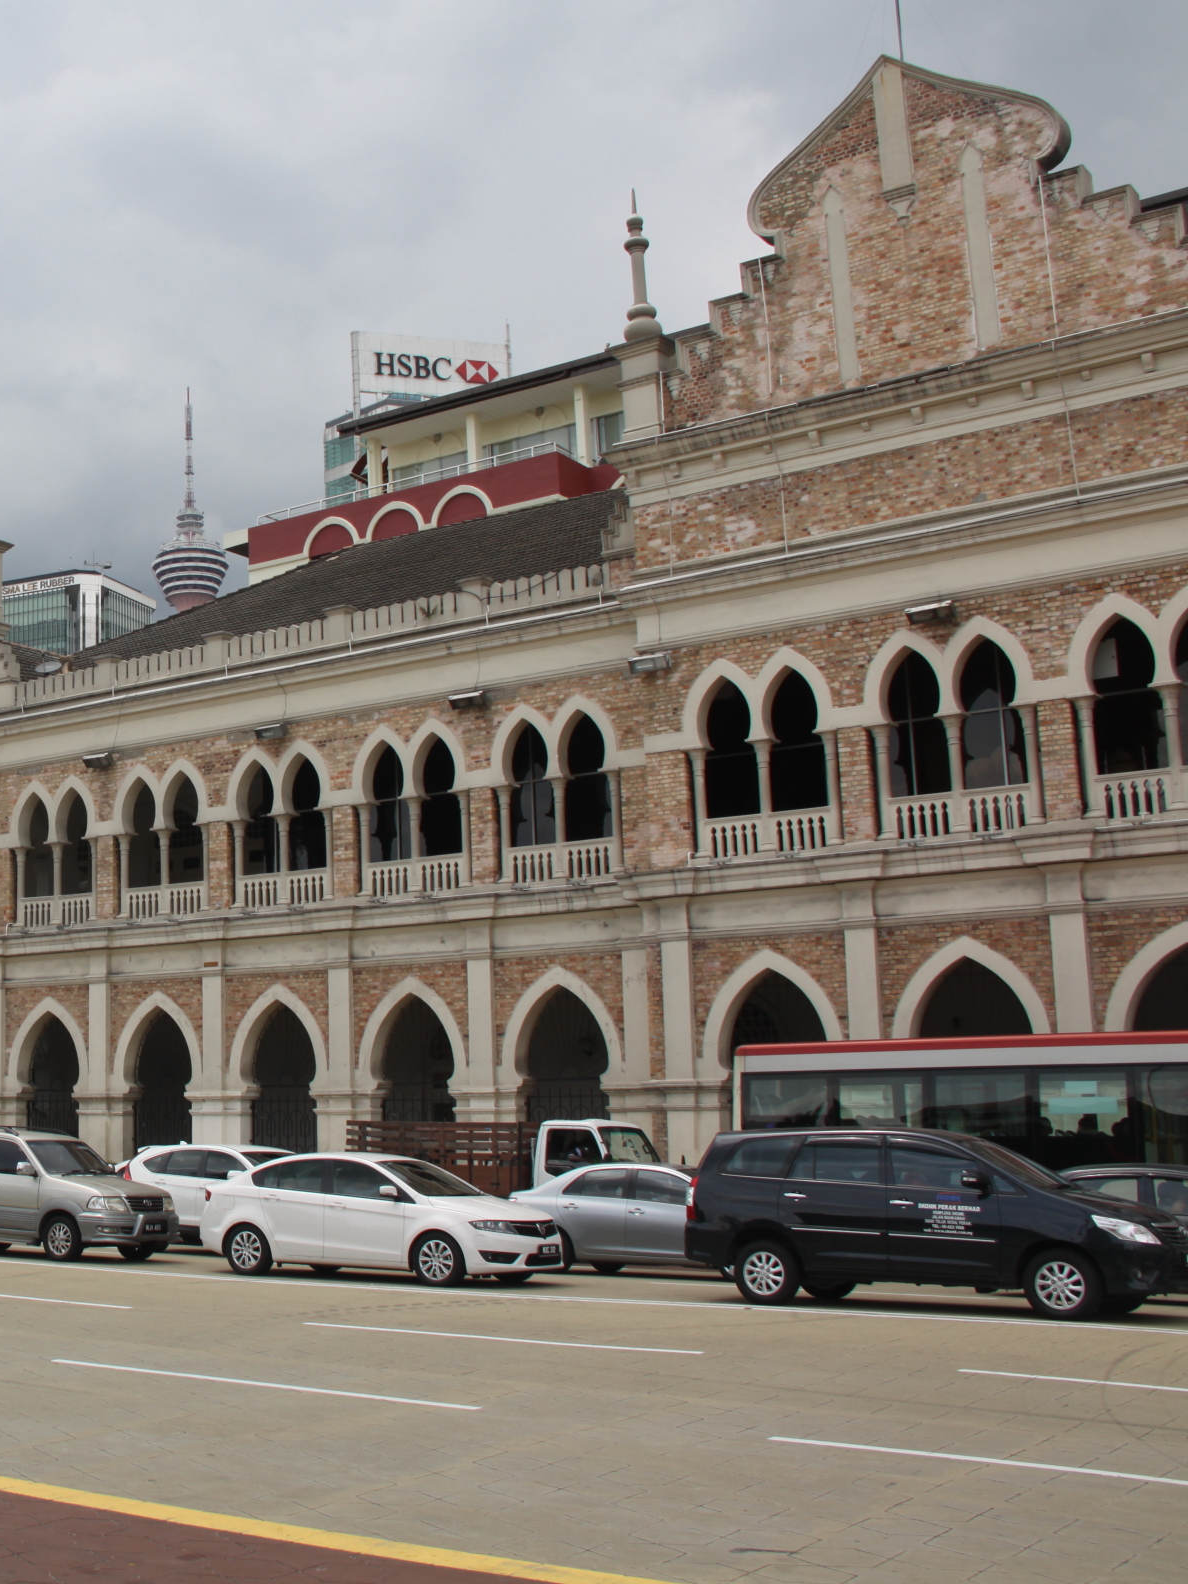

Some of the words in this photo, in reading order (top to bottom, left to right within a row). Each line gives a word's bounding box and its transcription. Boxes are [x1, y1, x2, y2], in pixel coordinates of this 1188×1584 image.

[374, 352, 452, 381] HSBC
[2, 585, 20, 595] SMA
[22, 582, 38, 592] LEE
[40, 576, 75, 589] RUBBER
